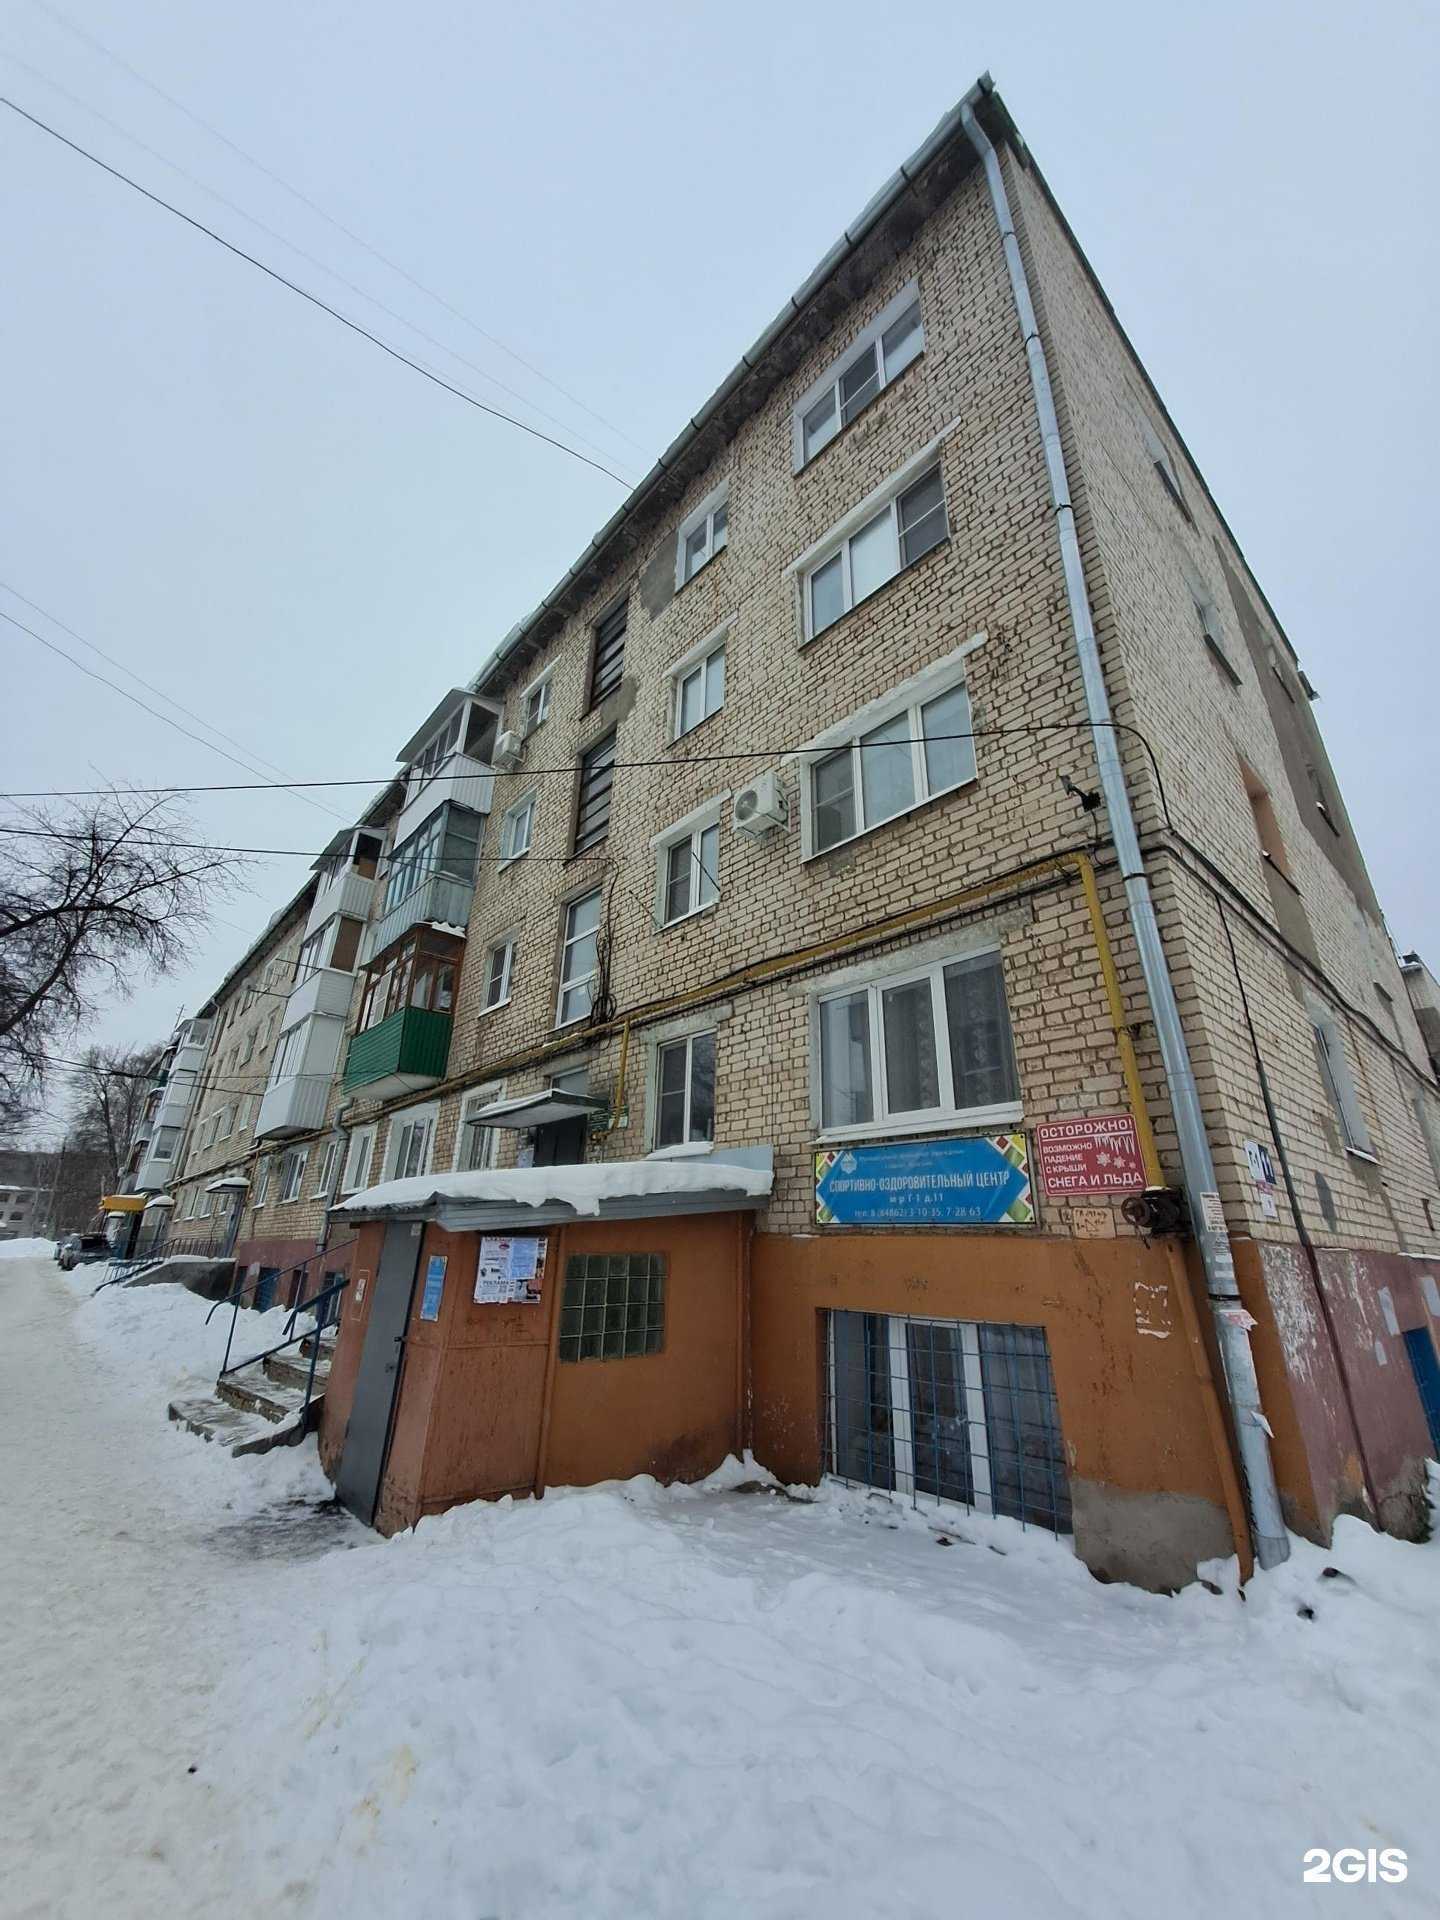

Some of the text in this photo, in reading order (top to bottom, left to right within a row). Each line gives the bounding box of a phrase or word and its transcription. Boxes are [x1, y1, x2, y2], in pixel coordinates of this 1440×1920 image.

[1040, 1118, 1133, 1139] ОСТОРОЖНО!
[1042, 1142, 1093, 1154] ВОЗМОЖНО
[1044, 1153, 1083, 1164] ПАДЕНИЕ
[1046, 1163, 1087, 1174] С КРЫШИ
[829, 1170, 1010, 1193] СПОРТИВНО-ОЗДОРОВИТЕЛЬНЫЙ ЦЕНТР
[1048, 1172, 1143, 1188] СНЕГА И ЛЬДА
